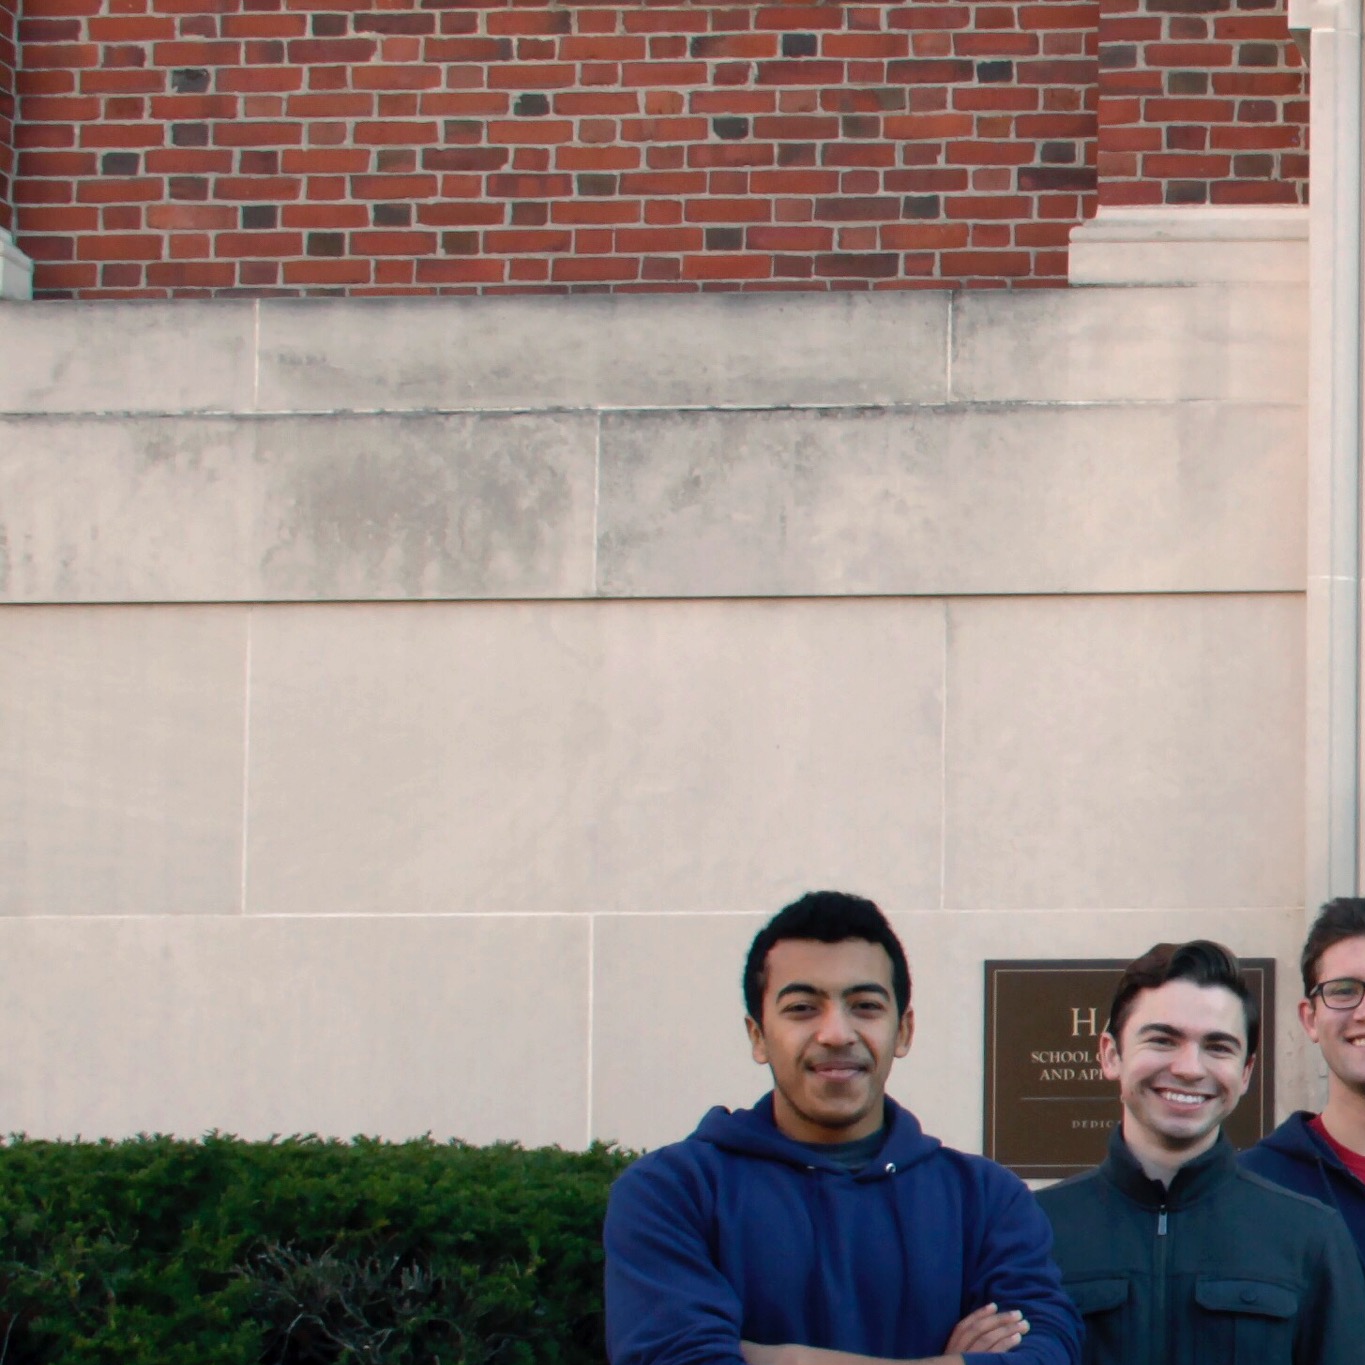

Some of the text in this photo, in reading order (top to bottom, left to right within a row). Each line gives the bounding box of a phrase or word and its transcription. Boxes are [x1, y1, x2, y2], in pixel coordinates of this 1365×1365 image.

[1031, 1050, 1092, 1063] SCHOOL
[1040, 1068, 1075, 1080] AND
[1072, 1119, 1121, 1129] DEDIC
